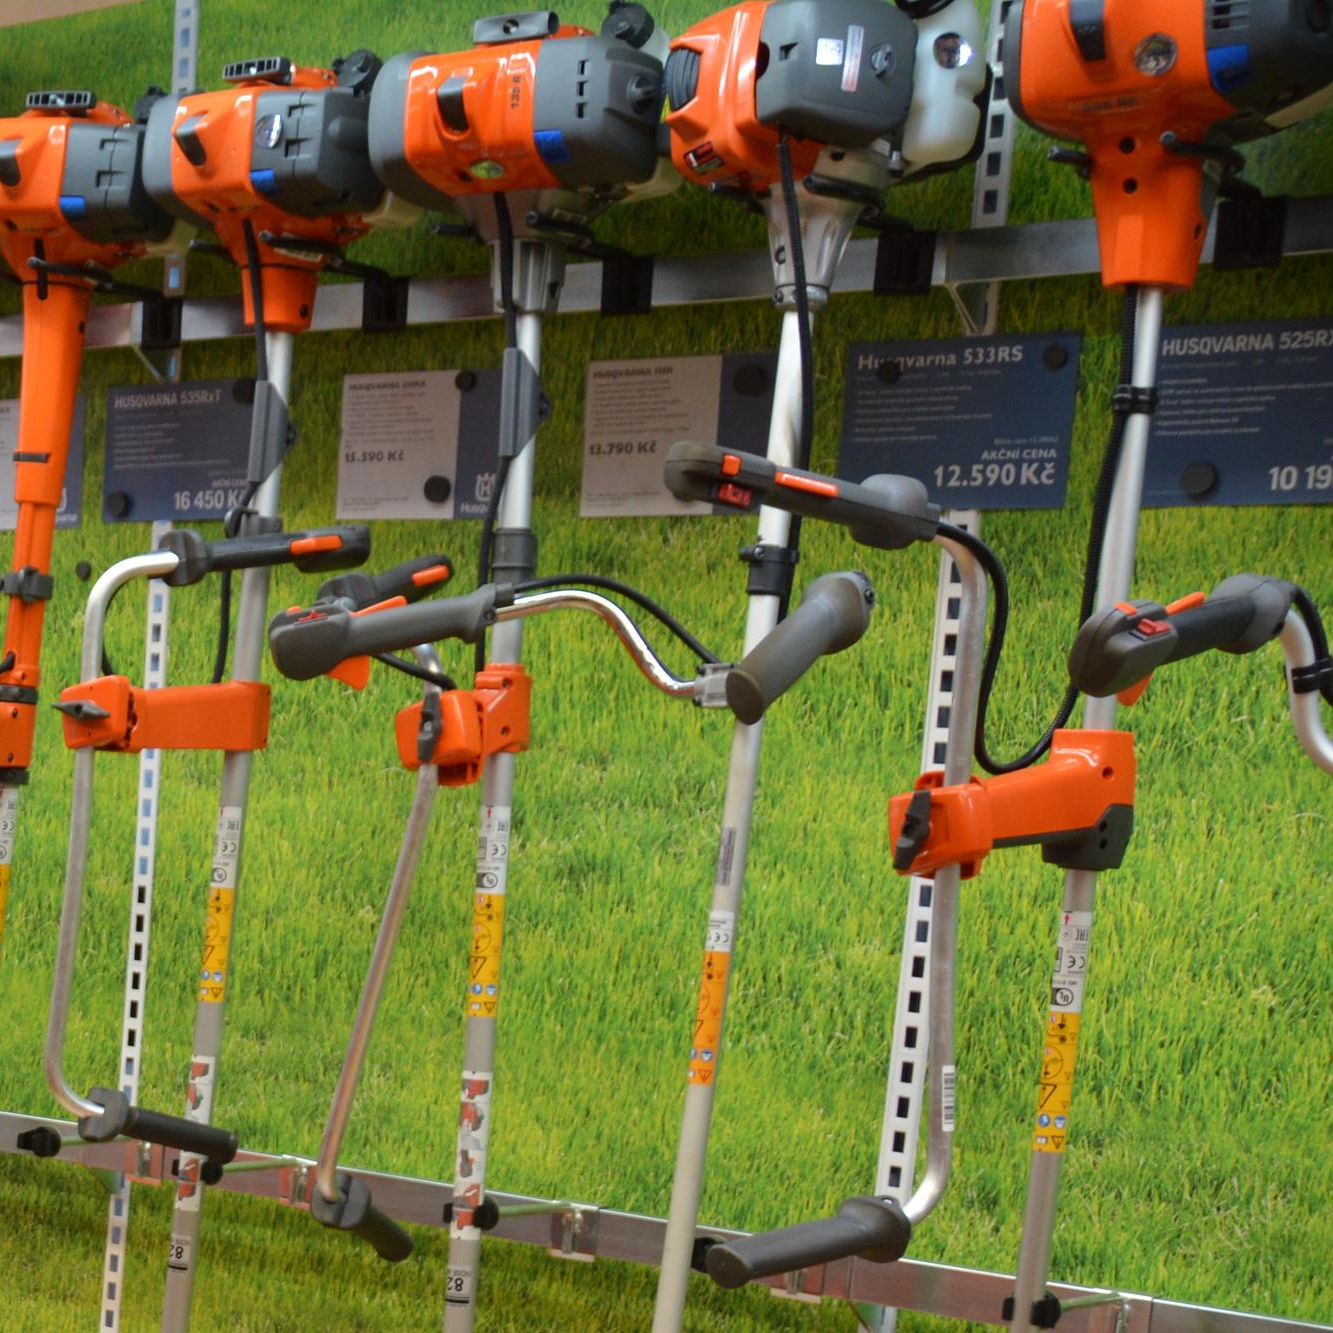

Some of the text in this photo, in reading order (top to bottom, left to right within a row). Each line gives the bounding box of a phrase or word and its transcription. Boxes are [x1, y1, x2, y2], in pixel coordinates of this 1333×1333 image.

[964, 346, 1024, 364] 533RS
[1162, 334, 1274, 357] HUSQVARNA
[345, 450, 405, 463] 15.590 Kč
[588, 440, 657, 457] 13.790 Kč
[981, 448, 1057, 461] AKČNÍ CENA
[934, 461, 1056, 488] 12.590 Kč
[1269, 467, 1297, 492] 10
[174, 490, 225, 511] 16 450
